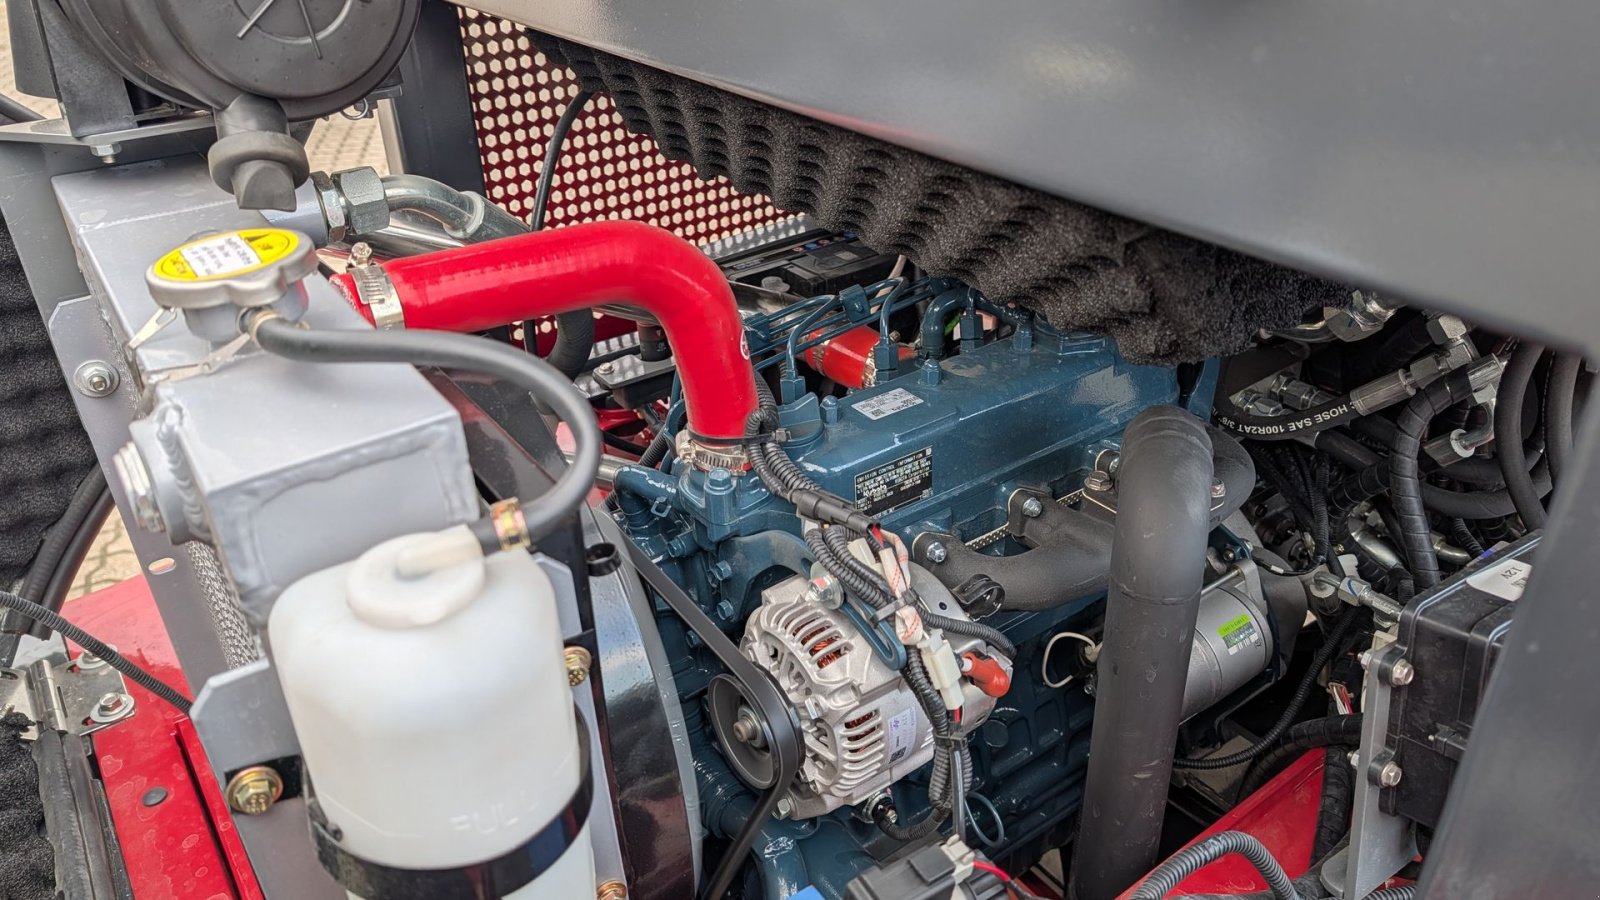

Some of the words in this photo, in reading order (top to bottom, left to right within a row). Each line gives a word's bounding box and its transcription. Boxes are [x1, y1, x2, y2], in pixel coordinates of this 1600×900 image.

[1314, 404, 1348, 423] HOSE
[1237, 424, 1285, 435] 100R2AT
[1287, 417, 1313, 431] SAE
[878, 464, 895, 475] CONTROL
[897, 453, 923, 467] INFORMATION
[449, 789, 539, 836] FULL
